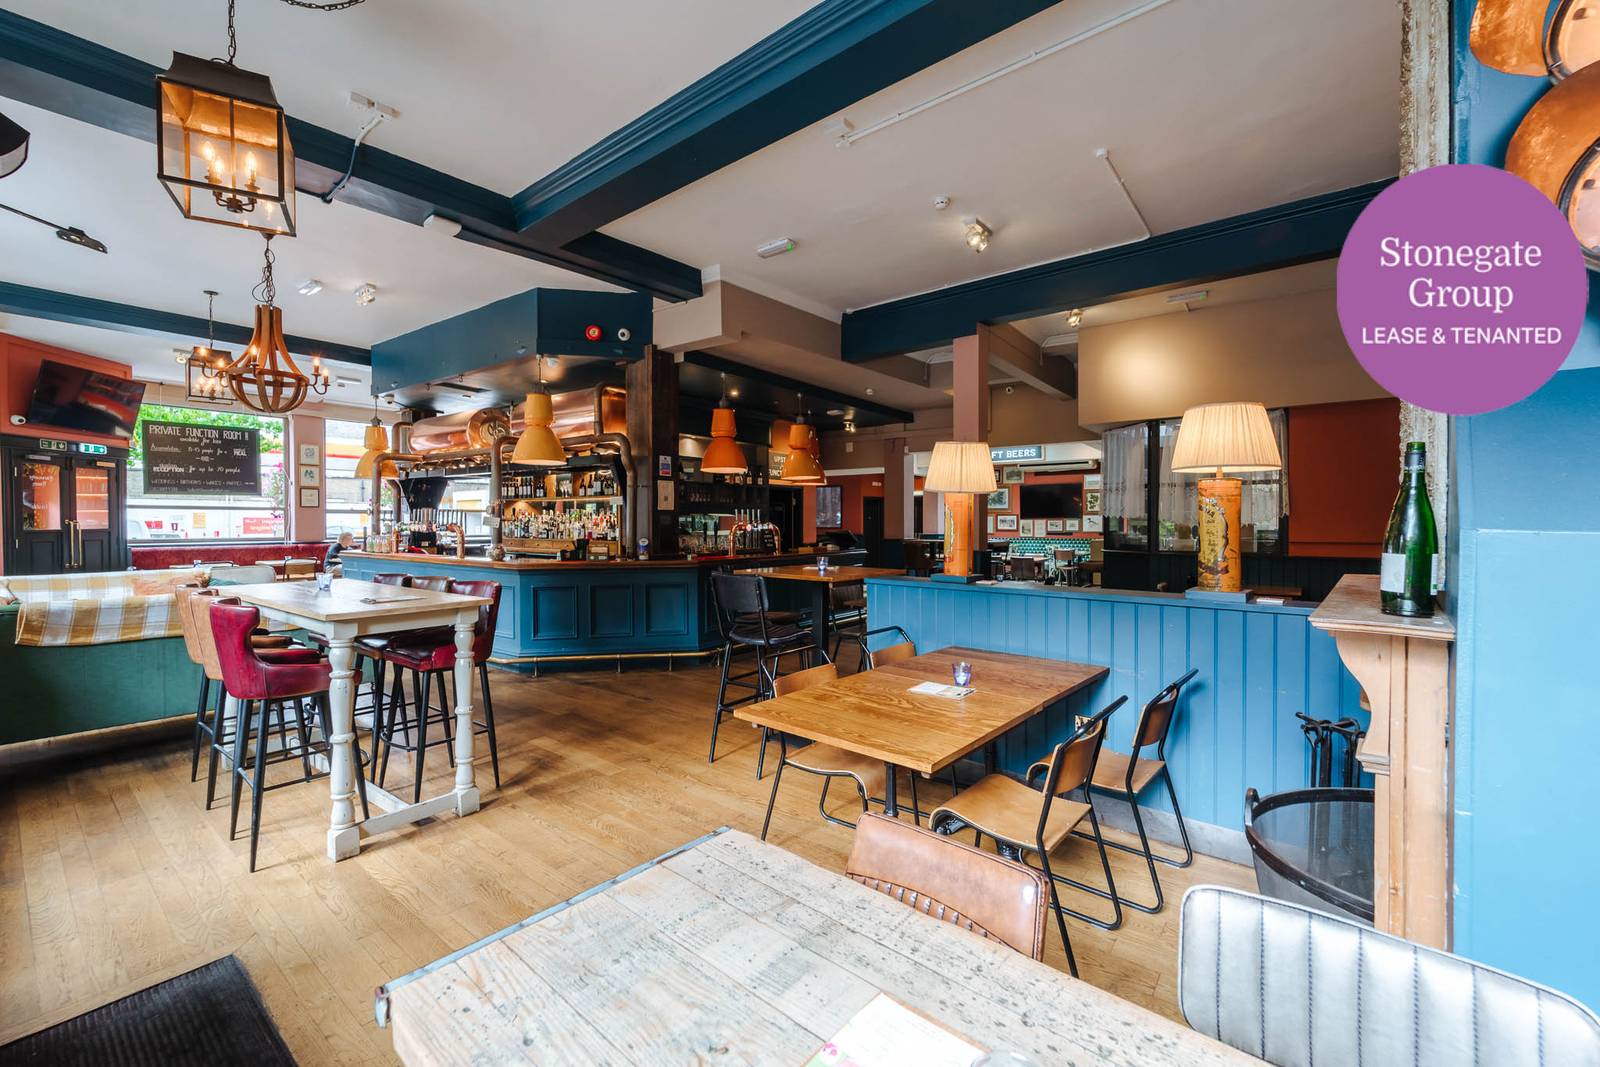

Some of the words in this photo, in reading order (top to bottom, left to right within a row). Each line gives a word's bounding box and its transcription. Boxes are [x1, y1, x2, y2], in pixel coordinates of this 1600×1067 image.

[149, 425, 181, 436] PRIVATE
[185, 428, 219, 439] FUNCTION
[223, 431, 242, 440] ROOM
[773, 455, 786, 463] UPST
[991, 451, 1003, 459] FT
[1006, 448, 1036, 458] BEERS
